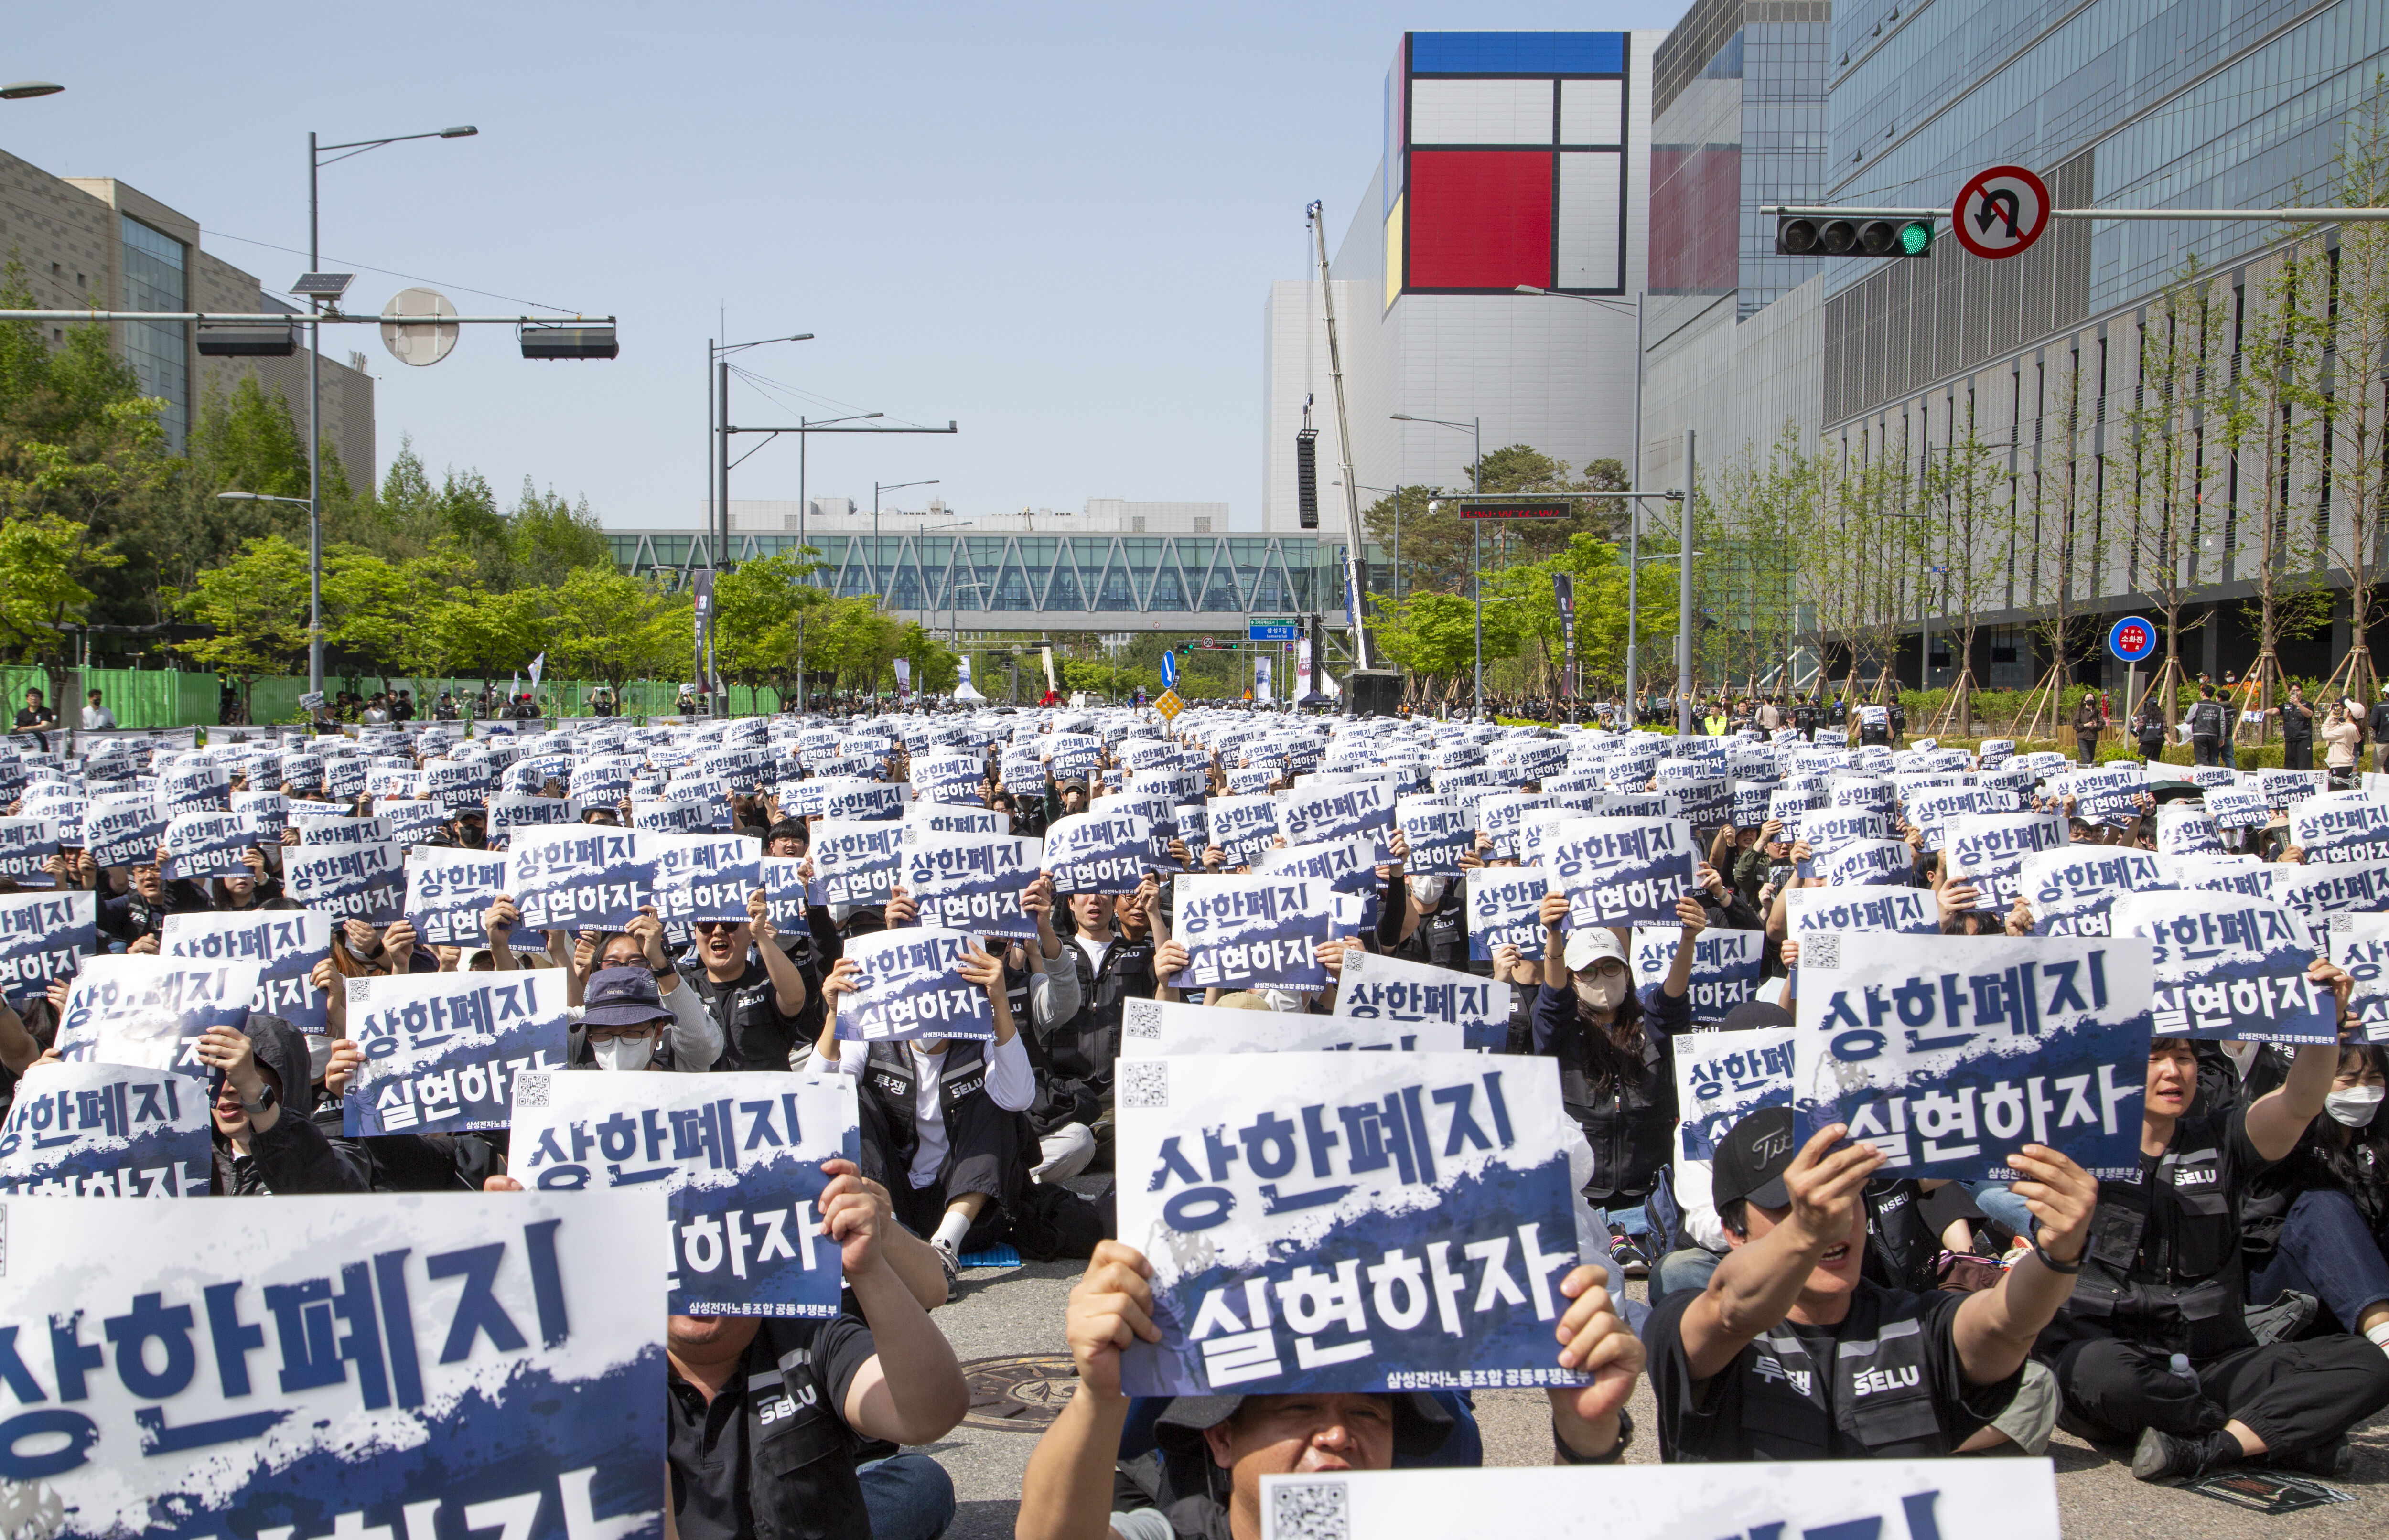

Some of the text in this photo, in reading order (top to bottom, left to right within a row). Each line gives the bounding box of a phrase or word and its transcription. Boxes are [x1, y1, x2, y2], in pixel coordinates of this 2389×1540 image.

[2121, 635, 2143, 643] 소화전
[696, 731, 723, 743] 상한폐지
[731, 719, 763, 736] 상한폐지
[931, 727, 963, 746] 상한폐지
[1130, 727, 1160, 739] 상한폐지
[1342, 729, 1372, 741] 상한폐지
[1816, 733, 1843, 741] 상한폐지
[538, 741, 569, 753] 상한폐지
[591, 737, 619, 750] 상한폐지
[799, 734, 834, 747] 상한폐지
[843, 738, 883, 753] 상한폐지
[1053, 737, 1094, 752] 상한폐지
[1218, 733, 1253, 749] 상한폐지
[1244, 742, 1283, 759] 상한폐지
[1629, 740, 1668, 756] 상한폐지
[1675, 738, 1719, 757] 상한폐지
[1982, 742, 2012, 752] 상한폐지
[651, 750, 685, 759] 상한폐지
[705, 752, 753, 774] 상한폐지
[800, 748, 835, 759] 실현하자
[1055, 752, 1099, 767] 실현하자
[1131, 744, 1175, 762] 상한폐지
[1339, 750, 1378, 761] 상한폐지
[1442, 747, 1480, 764] 상한폐지
[1520, 745, 1560, 764] 상한폐지
[1796, 755, 1840, 770] 상한폐지
[1983, 753, 2014, 763] 실현하자
[2031, 753, 2061, 765] 상한폐지
[87, 760, 129, 778] 상한폐지
[247, 758, 280, 776] 상한폐지
[284, 758, 321, 774] 상한폐지
[328, 759, 372, 780] 상한폐지
[427, 765, 483, 786] 상한폐지
[819, 757, 868, 777] 상한폐지
[915, 758, 974, 783] 상한폐지
[1005, 763, 1045, 778] 상한폐지
[1525, 765, 1567, 780] 실현하자
[1608, 757, 1656, 780] 상한폐지
[1731, 762, 1776, 780] 상한폐지
[2035, 766, 2065, 777] 실현하자
[2196, 770, 2231, 783] 상한폐지
[287, 775, 324, 791] 실현하자
[573, 768, 622, 788] 상한폐지
[1008, 780, 1045, 792] 실현하자
[1136, 776, 1197, 797] 상한폐지
[1230, 770, 1275, 790] 상한폐지
[1439, 771, 1489, 793] 상한폐지
[1982, 772, 2028, 788] 상한폐지
[2074, 772, 2131, 793] 상한폐지
[2262, 773, 2307, 790] 상한폐지
[431, 788, 489, 806] 실현하자
[829, 786, 901, 816] 상한폐지
[919, 781, 979, 802] 실현하자
[1838, 784, 1894, 806] 상한폐지
[2267, 791, 2314, 809] 실현하자
[379, 803, 435, 822] 상한폐지
[1286, 786, 1381, 833] 상한폐지
[1774, 793, 1828, 818] 상한폐지
[1918, 792, 1993, 822] 상한폐지
[2081, 793, 2138, 815] 실현하자
[2211, 795, 2261, 810] 상한폐지
[87, 805, 157, 841] 상한폐지
[494, 804, 569, 826] 상한폐지
[637, 806, 702, 833] 상한폐지
[2218, 810, 2272, 828] 실현하자
[2298, 805, 2388, 839] 상한폐지
[168, 816, 244, 848] 상한폐지
[305, 820, 380, 845] 상한폐지
[1049, 818, 1134, 856] 상한폐지
[1808, 816, 1882, 845] 상한폐지
[95, 833, 164, 867] 실현하자
[1554, 823, 1674, 877] 상한폐지
[1955, 821, 2060, 866] 상한폐지
[174, 845, 249, 877] 실현하자
[516, 834, 635, 879] 상한폐지
[910, 842, 1022, 883] 상한폐지
[1831, 845, 1903, 886] 상한폐지
[293, 845, 388, 890] 상한폐지
[1053, 856, 1150, 892] 실현하자
[2036, 855, 2160, 903] 상한폐지
[520, 882, 652, 929] 실현하자
[651, 879, 758, 917] 실현하자
[1183, 882, 1308, 934] 상한폐지
[1569, 874, 1692, 927] 실현하자
[917, 890, 1027, 929] 실현하자
[1799, 893, 1925, 933] 상한폐지
[1433, 918, 1454, 929] SELU
[2132, 908, 2295, 965] 상한폐지
[853, 936, 969, 991] 상한폐지
[1191, 935, 1317, 985] 실현하자
[69, 967, 229, 1028] 상한폐지
[738, 994, 764, 1009] SELU
[1348, 981, 1490, 1023] 상한폐지
[1821, 950, 2107, 1062] 상한폐지
[2152, 972, 2332, 1034] 실현하자
[358, 977, 537, 1059] 상한폐지
[859, 986, 989, 1039] 실현하자
[2238, 1032, 2335, 1044] 삼성전자노동조합 공동투쟁본부
[873, 1073, 907, 1096] 투쟁
[951, 1076, 984, 1098] SELU
[314, 1099, 344, 1114] ELU
[1847, 1064, 2144, 1169] 실현하자
[0, 1080, 180, 1158] 상한폐지
[528, 1093, 801, 1191] 상한폐지
[1147, 1070, 1516, 1232] 상한폐지
[2174, 1170, 2217, 1186] SELU
[1878, 1189, 1909, 1214] NSEU
[689, 1302, 838, 1317] 삼성전자노동조합 공동투쟁본부
[1189, 1222, 1579, 1388] 실현하자
[0, 1218, 570, 1480] 상한폐지
[1387, 1369, 1503, 1389] 삼성전자노동조합
[1853, 1366, 1920, 1396] SELU
[756, 1384, 817, 1425] SELU
